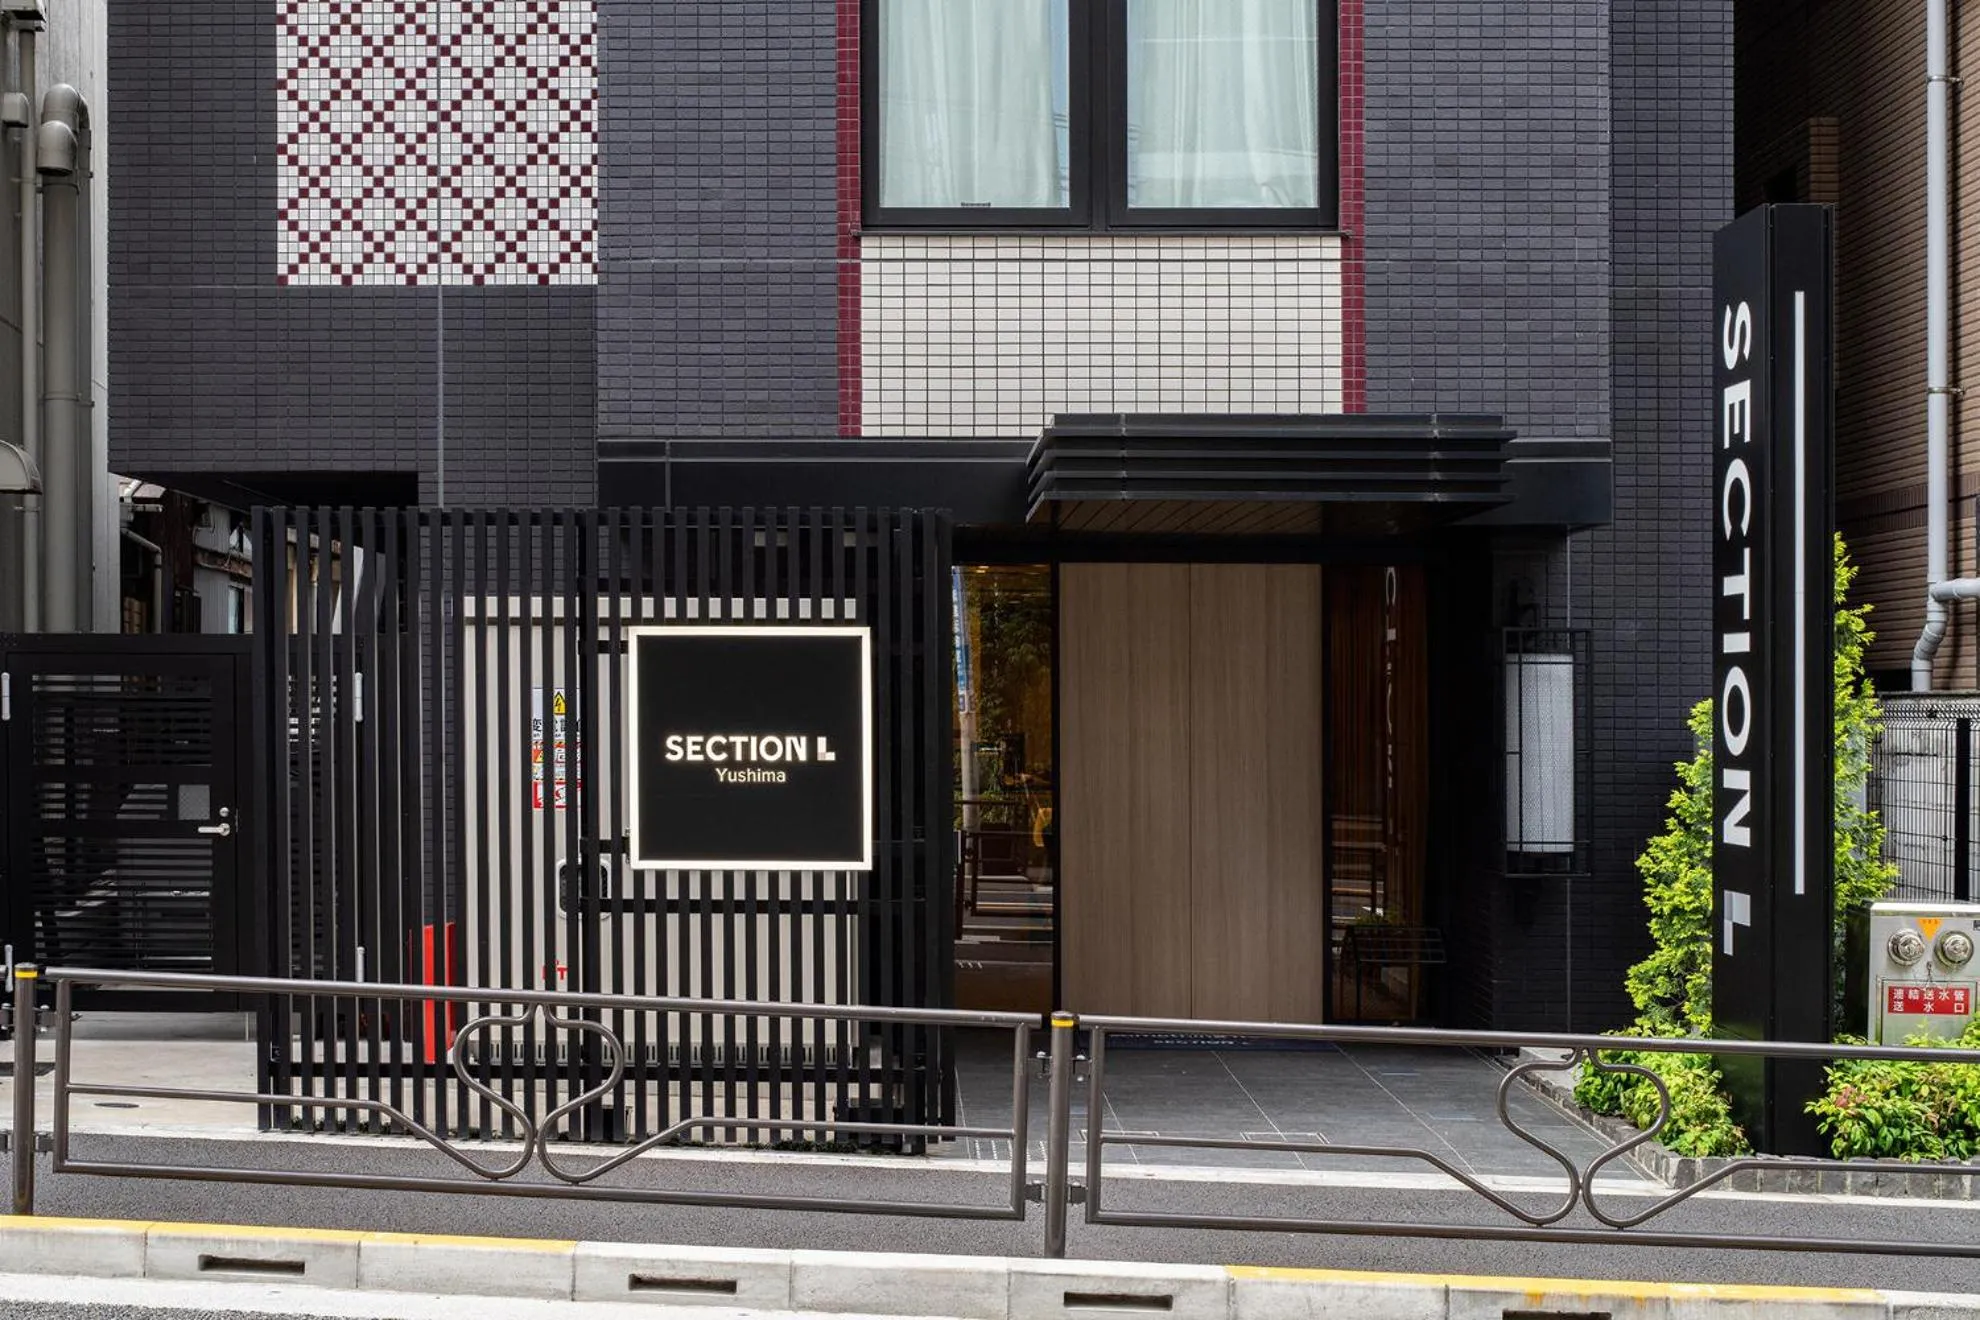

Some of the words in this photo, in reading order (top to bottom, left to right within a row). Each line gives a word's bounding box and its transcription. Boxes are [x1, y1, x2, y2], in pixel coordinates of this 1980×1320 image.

[1723, 301, 1752, 847] SECTION
[664, 735, 808, 762] SECTION
[817, 736, 836, 762] L
[715, 768, 787, 783] Yushima
[1723, 890, 1752, 957] L
